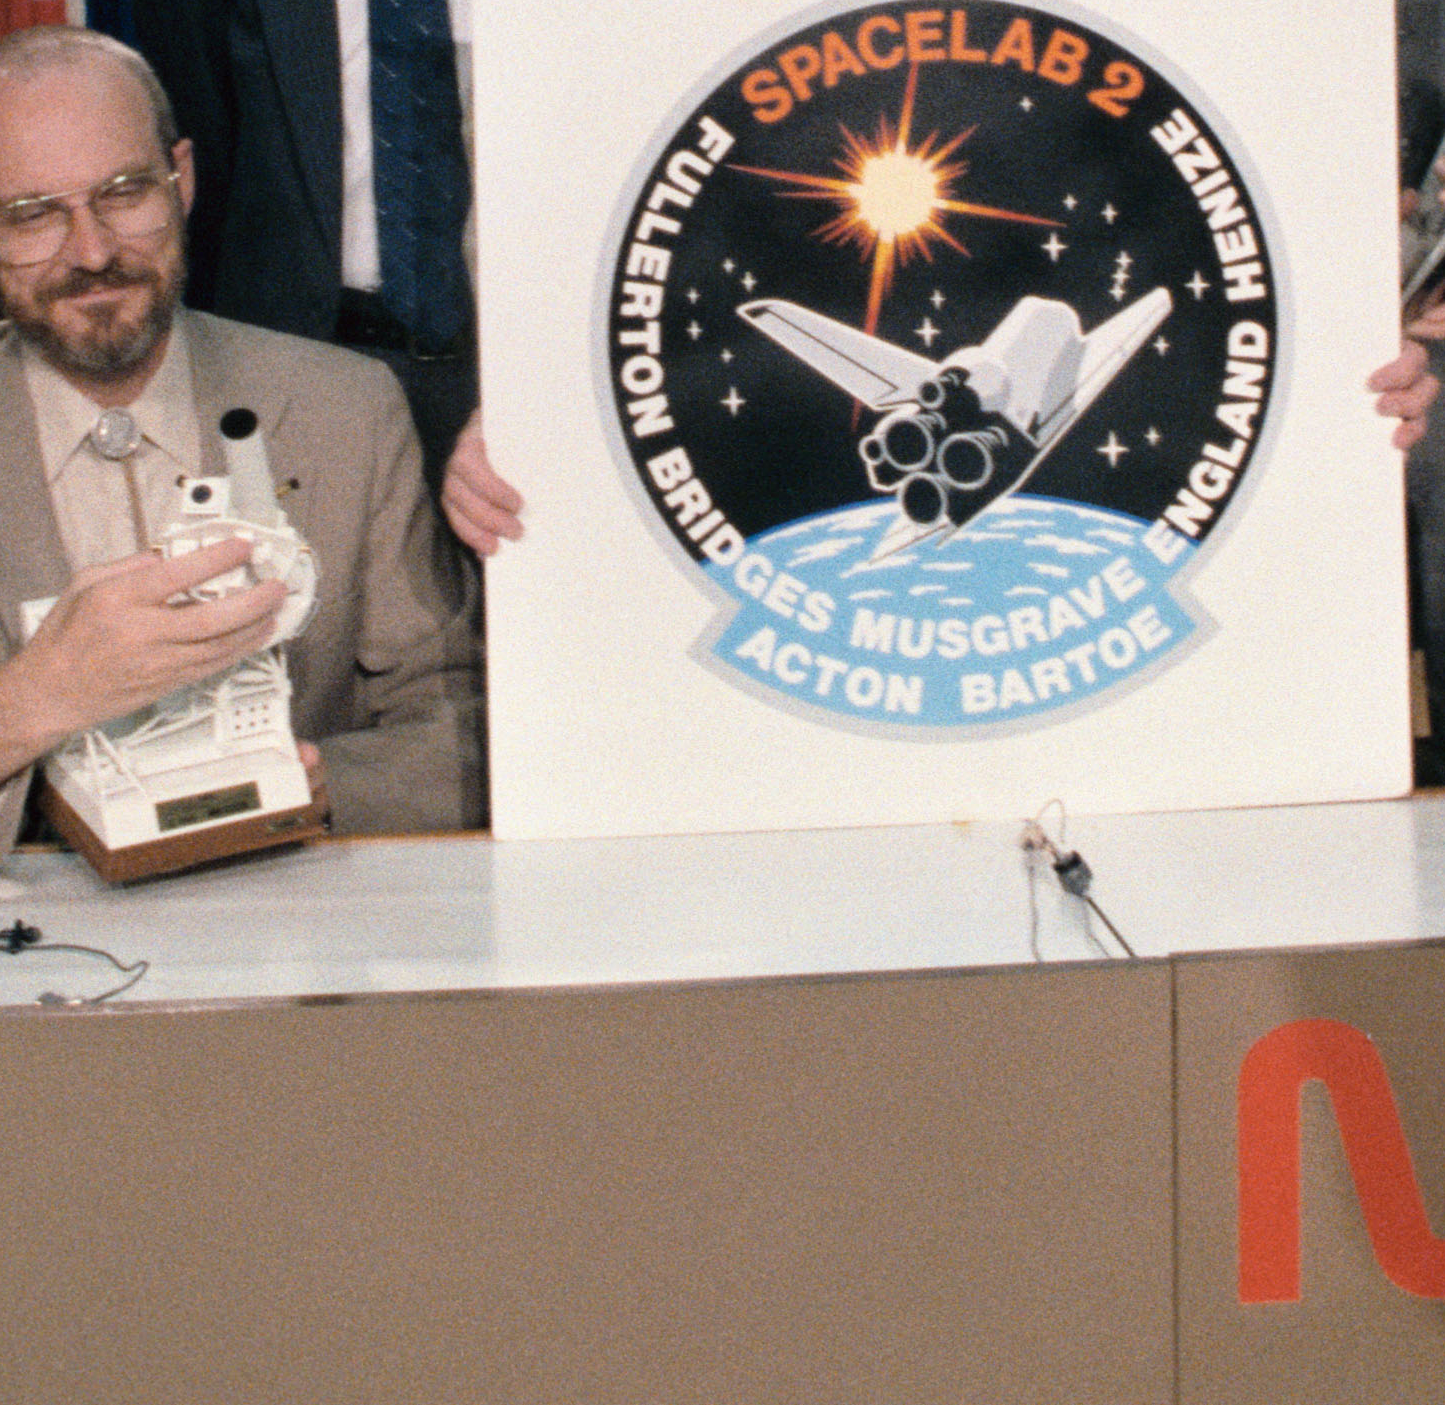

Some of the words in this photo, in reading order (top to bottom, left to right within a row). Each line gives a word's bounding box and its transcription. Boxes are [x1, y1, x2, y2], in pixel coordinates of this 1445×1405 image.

[741, 8, 1090, 123] SPACELAB
[1088, 60, 1145, 118] 2
[619, 115, 736, 438] FULLERTON
[1150, 107, 1267, 302] HENIZE
[1142, 320, 1269, 564] ENGLAND
[646, 446, 836, 633] BRIDGES
[850, 556, 1146, 659] MUSGRAVE
[735, 624, 924, 713] ACTON
[960, 605, 1173, 713] BARTOE
